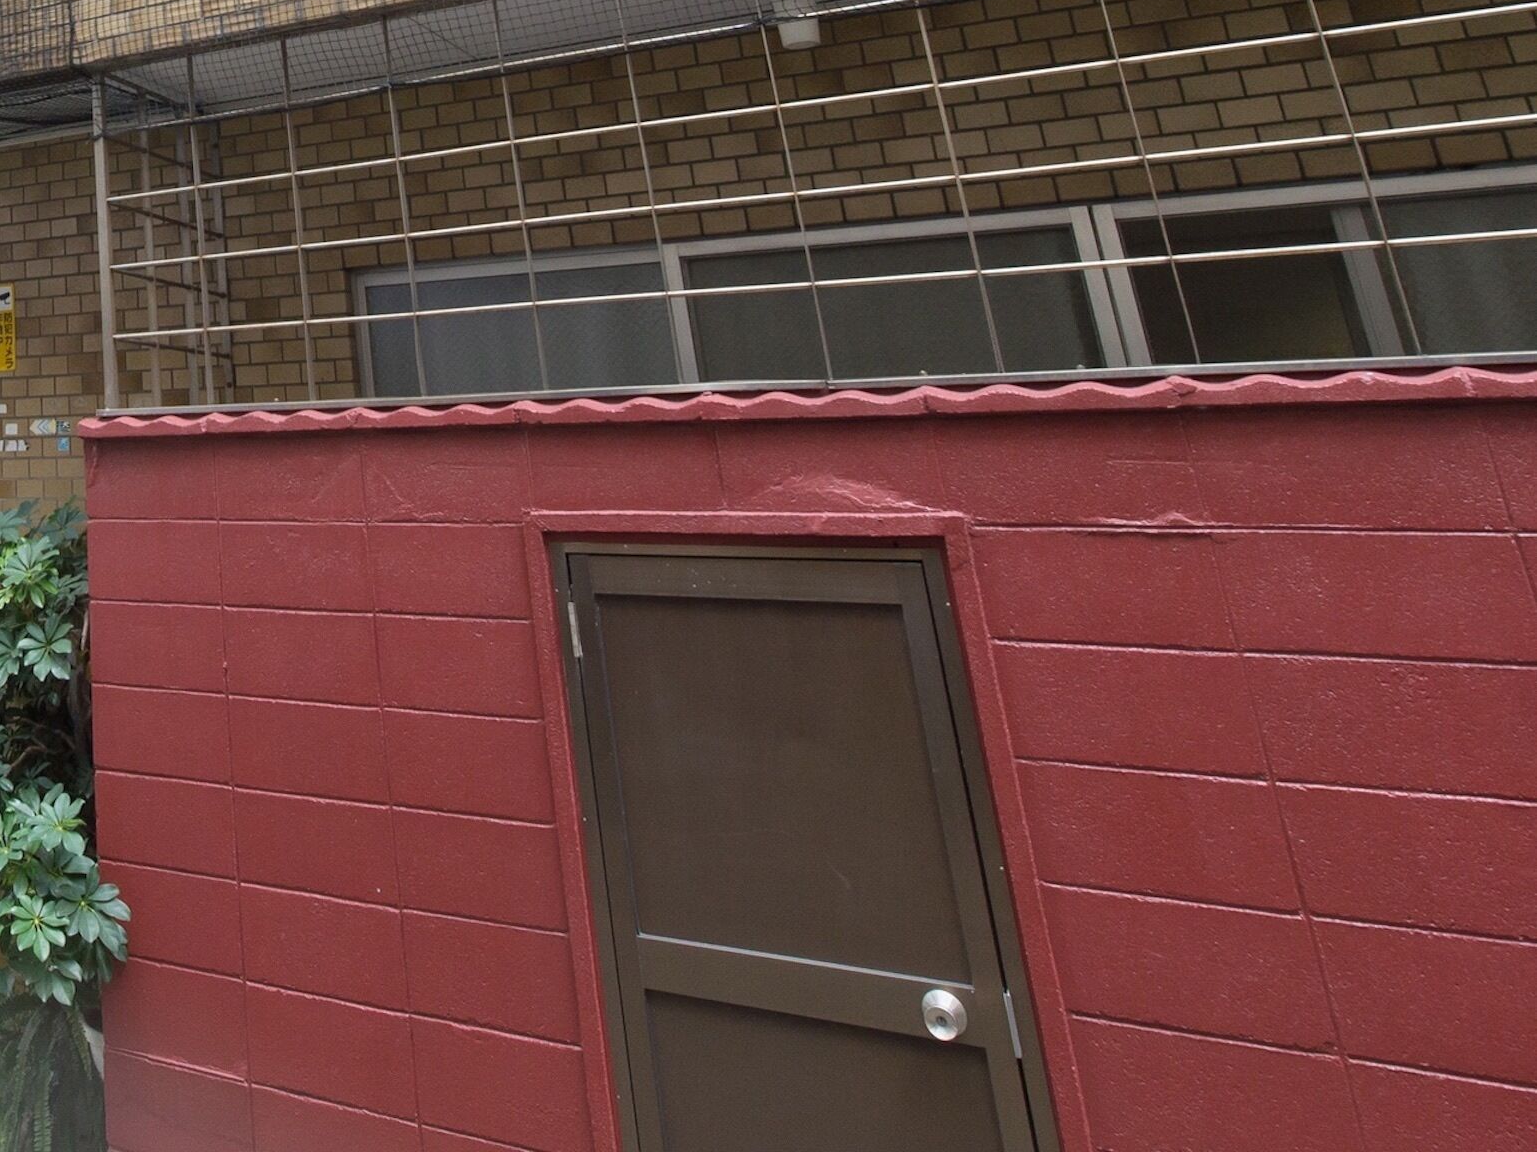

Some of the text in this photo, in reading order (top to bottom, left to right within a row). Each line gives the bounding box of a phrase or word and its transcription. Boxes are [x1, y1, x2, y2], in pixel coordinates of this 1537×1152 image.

[4, 312, 13, 369] 防犯カメラ
